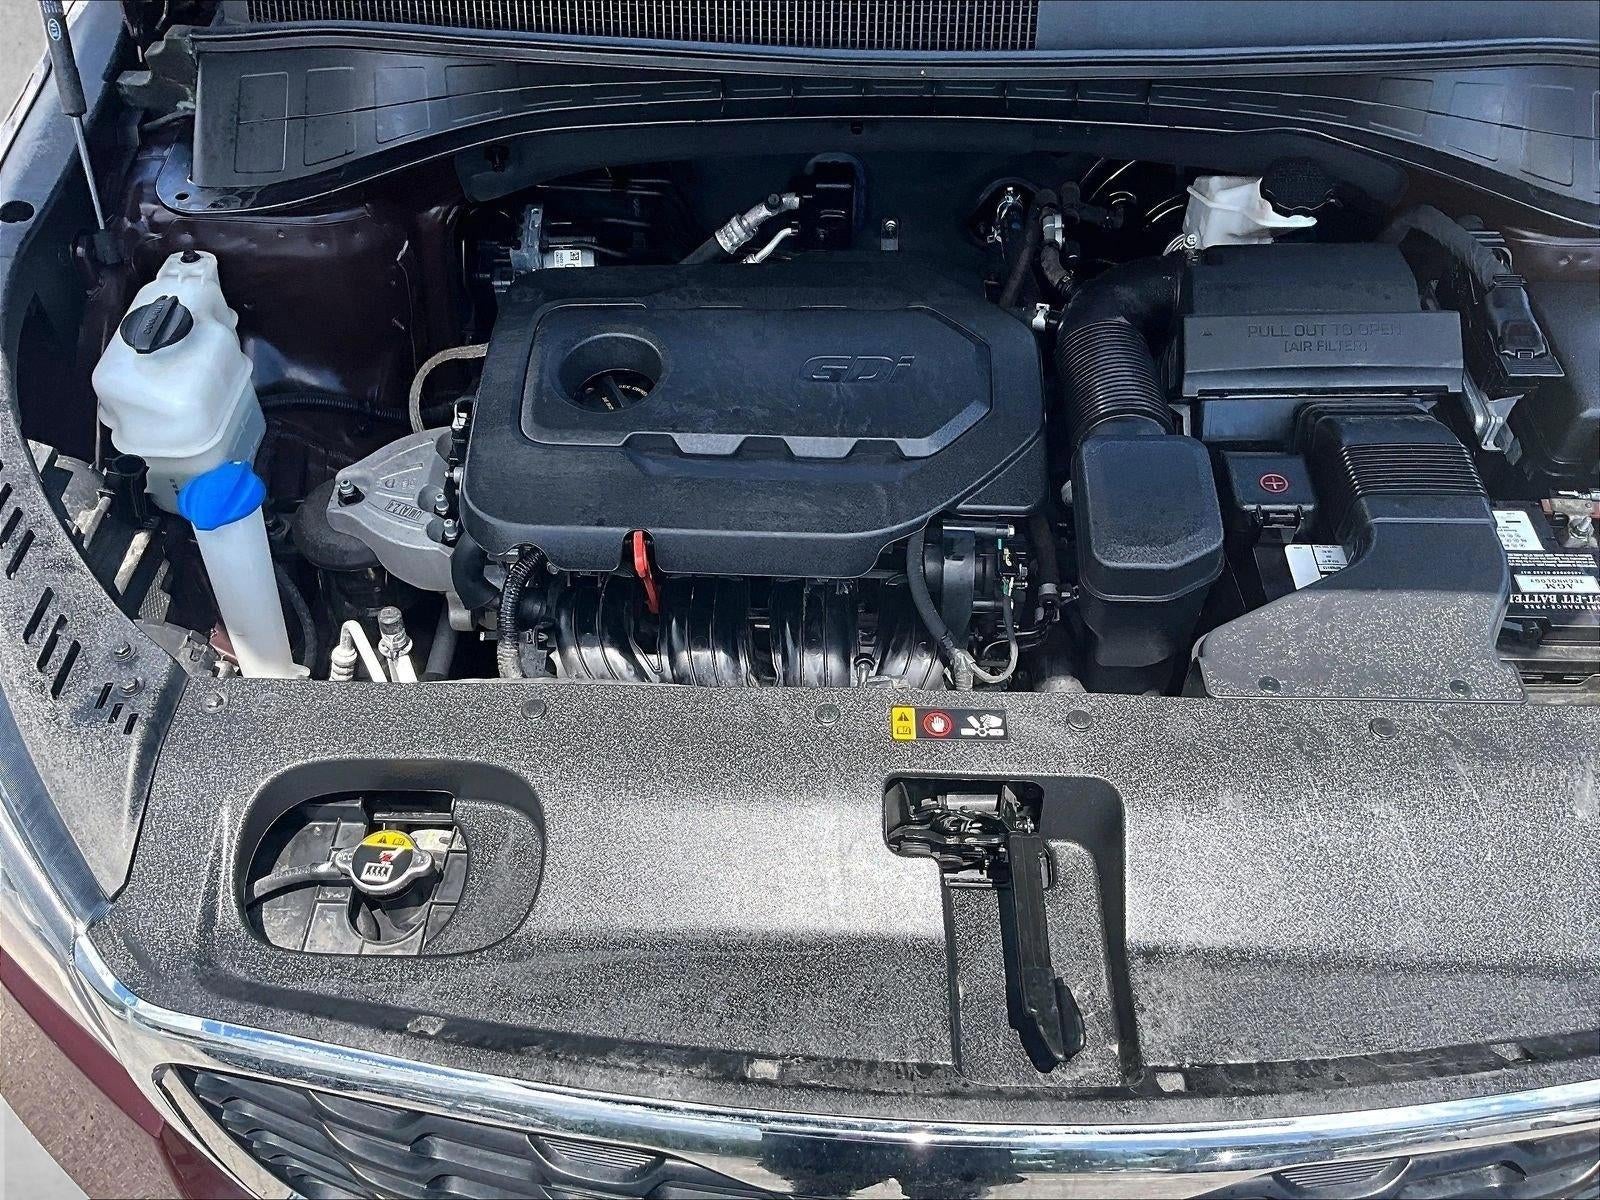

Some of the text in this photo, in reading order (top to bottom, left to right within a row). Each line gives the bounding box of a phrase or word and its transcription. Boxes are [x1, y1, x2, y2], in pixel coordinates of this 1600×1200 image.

[1248, 323, 1401, 337] PULL OUT TO OPEN
